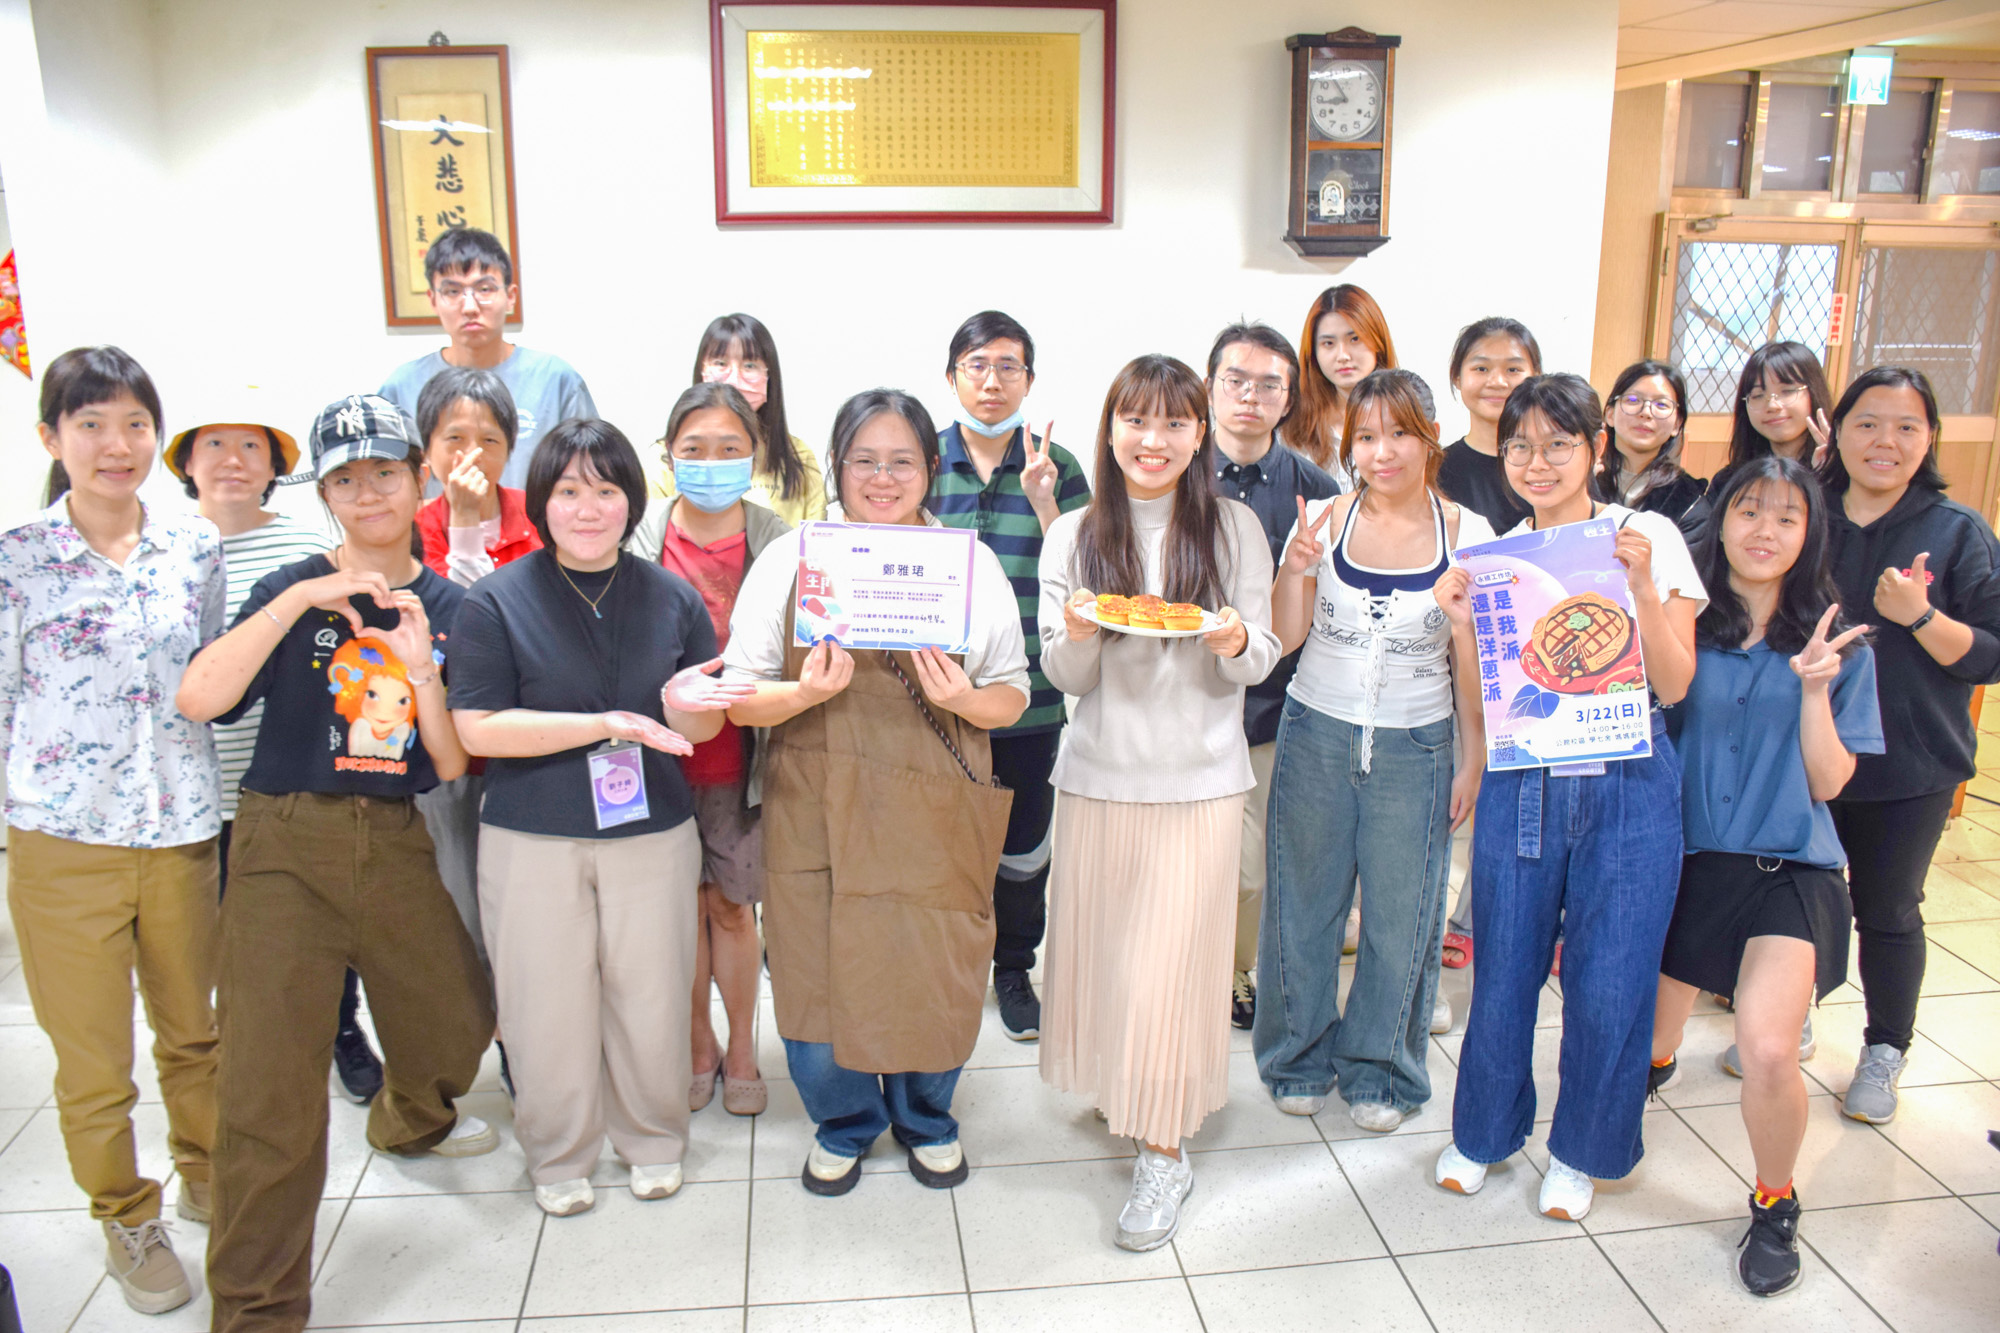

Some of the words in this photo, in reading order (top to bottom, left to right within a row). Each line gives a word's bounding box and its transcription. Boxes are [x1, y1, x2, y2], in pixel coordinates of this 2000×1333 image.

[1471, 592, 1502, 702] 還是洋蔥派
[1493, 589, 1521, 661] 是我派
[1575, 702, 1642, 724] 3/22(日)
